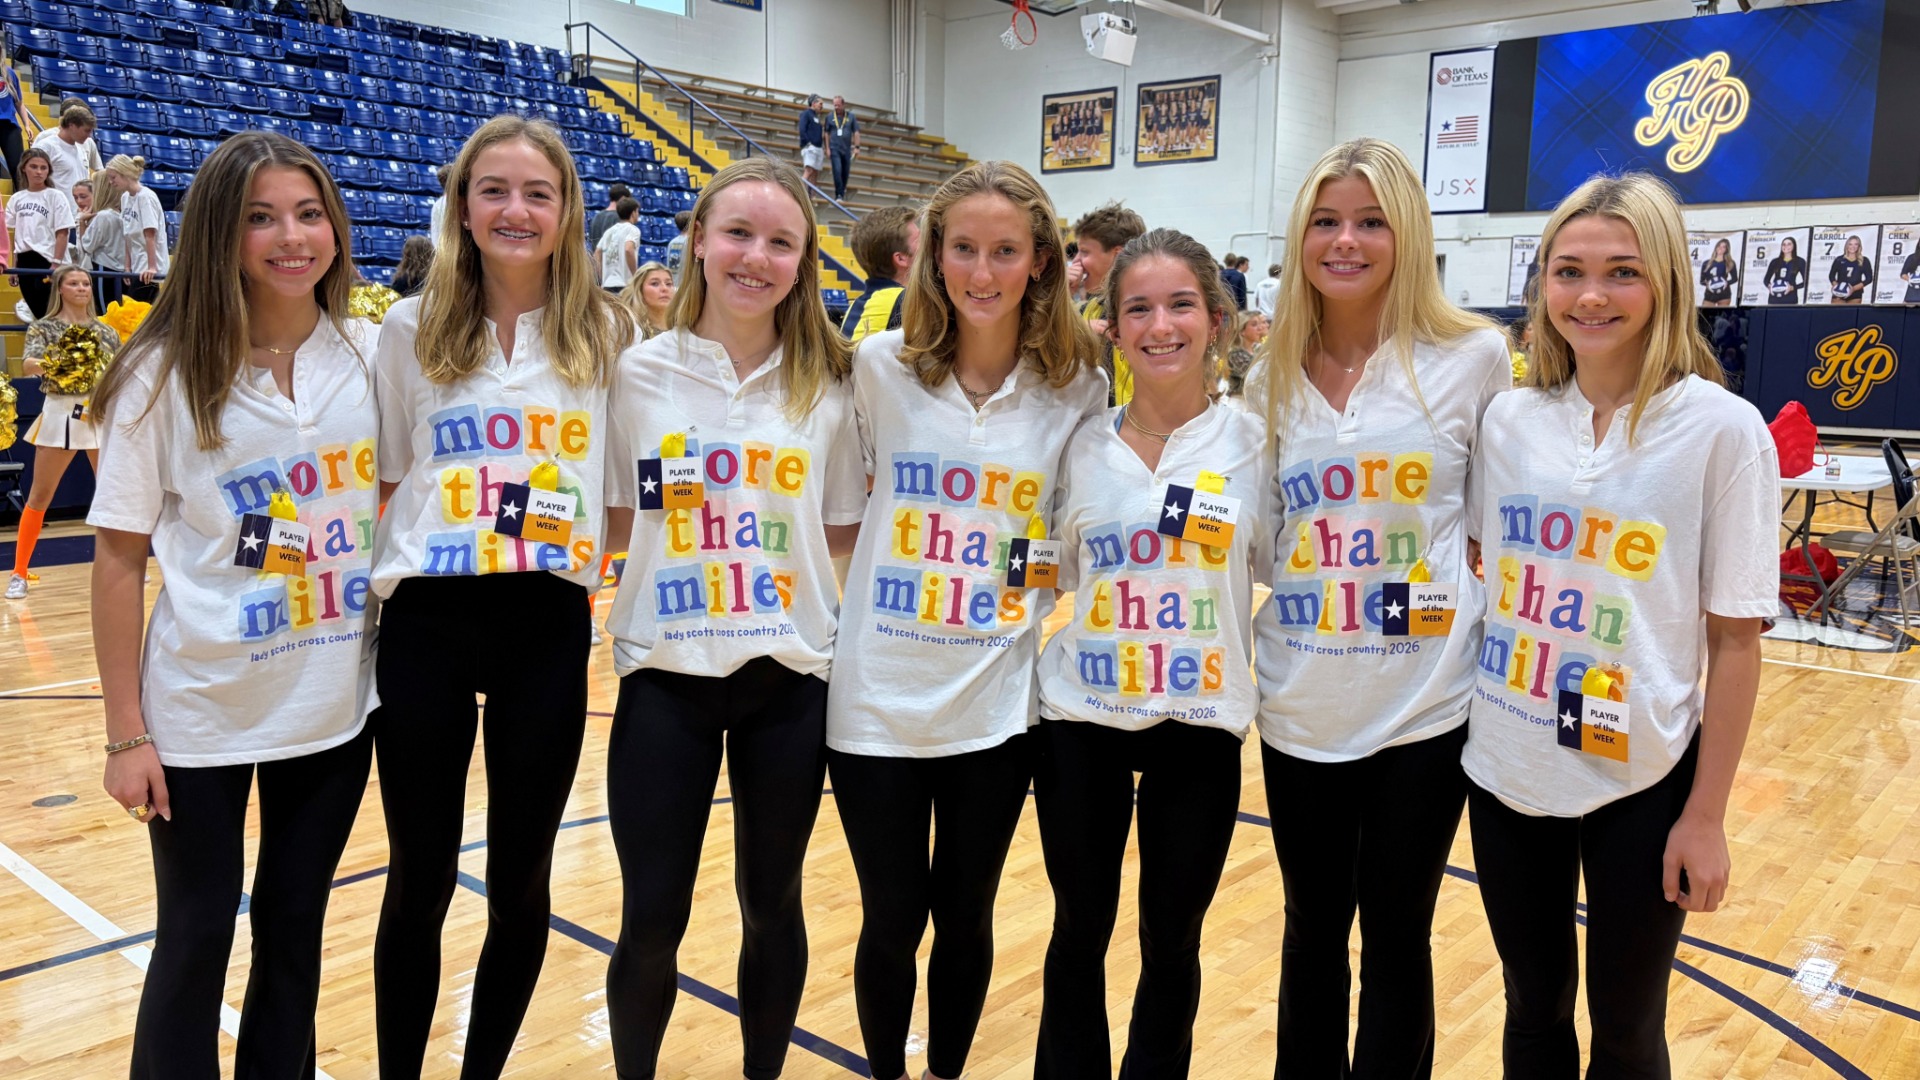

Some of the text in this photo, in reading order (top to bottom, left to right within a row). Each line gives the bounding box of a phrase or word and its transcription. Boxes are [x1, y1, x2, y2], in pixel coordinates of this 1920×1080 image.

[1452, 66, 1474, 75] BANK
[1452, 72, 1488, 82] OF TEXAS
[1634, 51, 1749, 173] HP
[1434, 178, 1477, 197] JSX
[1814, 233, 1848, 241] CARROLL
[1888, 232, 1910, 240] CHEN
[1690, 247, 1699, 260] 4
[1756, 246, 1766, 260] 6
[1824, 242, 1835, 256] 7
[1892, 242, 1903, 256] 8
[1521, 251, 1526, 264] 1
[1846, 266, 1854, 278] 7
[1807, 324, 1898, 411] HP
[433, 413, 588, 457] more
[669, 469, 696, 477] PLAYER
[686, 448, 804, 491] ore
[223, 447, 376, 516] more
[673, 479, 681, 487] of
[894, 461, 1039, 512] more
[1282, 459, 1428, 512] more
[673, 488, 694, 497] WEEK
[536, 500, 567, 513] PLAYER
[1199, 501, 1229, 515] PLAYER
[548, 514, 561, 522] the
[1210, 515, 1223, 524] the
[536, 521, 560, 532] WEEK
[666, 500, 788, 553] than
[1198, 522, 1221, 533] WEEK
[279, 531, 305, 544] PLAYER
[1500, 504, 1656, 572] more
[291, 544, 302, 553] the
[1033, 549, 1055, 558] PLAYER
[279, 552, 301, 563] WEEK
[1035, 559, 1042, 567] of
[1034, 568, 1050, 576] WEEK
[656, 562, 793, 616] miles
[243, 571, 369, 638] mile
[876, 576, 1025, 626] miles
[1090, 580, 1219, 630] than
[1417, 594, 1448, 602] PLAYER
[1499, 564, 1624, 645] than
[1275, 582, 1383, 632] mile
[1421, 604, 1444, 612] of the
[1420, 615, 1444, 623] WEEK
[664, 630, 684, 641] lady
[686, 627, 715, 639] scots
[737, 625, 777, 638] country
[779, 623, 797, 636] 202
[876, 622, 1016, 648] lady scots cross country 2026
[271, 642, 296, 656] scots
[298, 636, 326, 648] cross
[328, 630, 364, 643] countr
[1285, 637, 1303, 651] lady
[1316, 645, 1345, 656] cross
[1347, 644, 1387, 656] country
[1389, 640, 1421, 655] 2026
[1079, 643, 1223, 693] miles
[1127, 706, 1148, 717] cross
[1188, 706, 1217, 720] 2026
[1487, 693, 1507, 710] scots
[1508, 704, 1528, 720] cross
[1590, 709, 1620, 724] PLAYER
[1593, 722, 1616, 734] of the
[1593, 732, 1616, 745] WEEK
